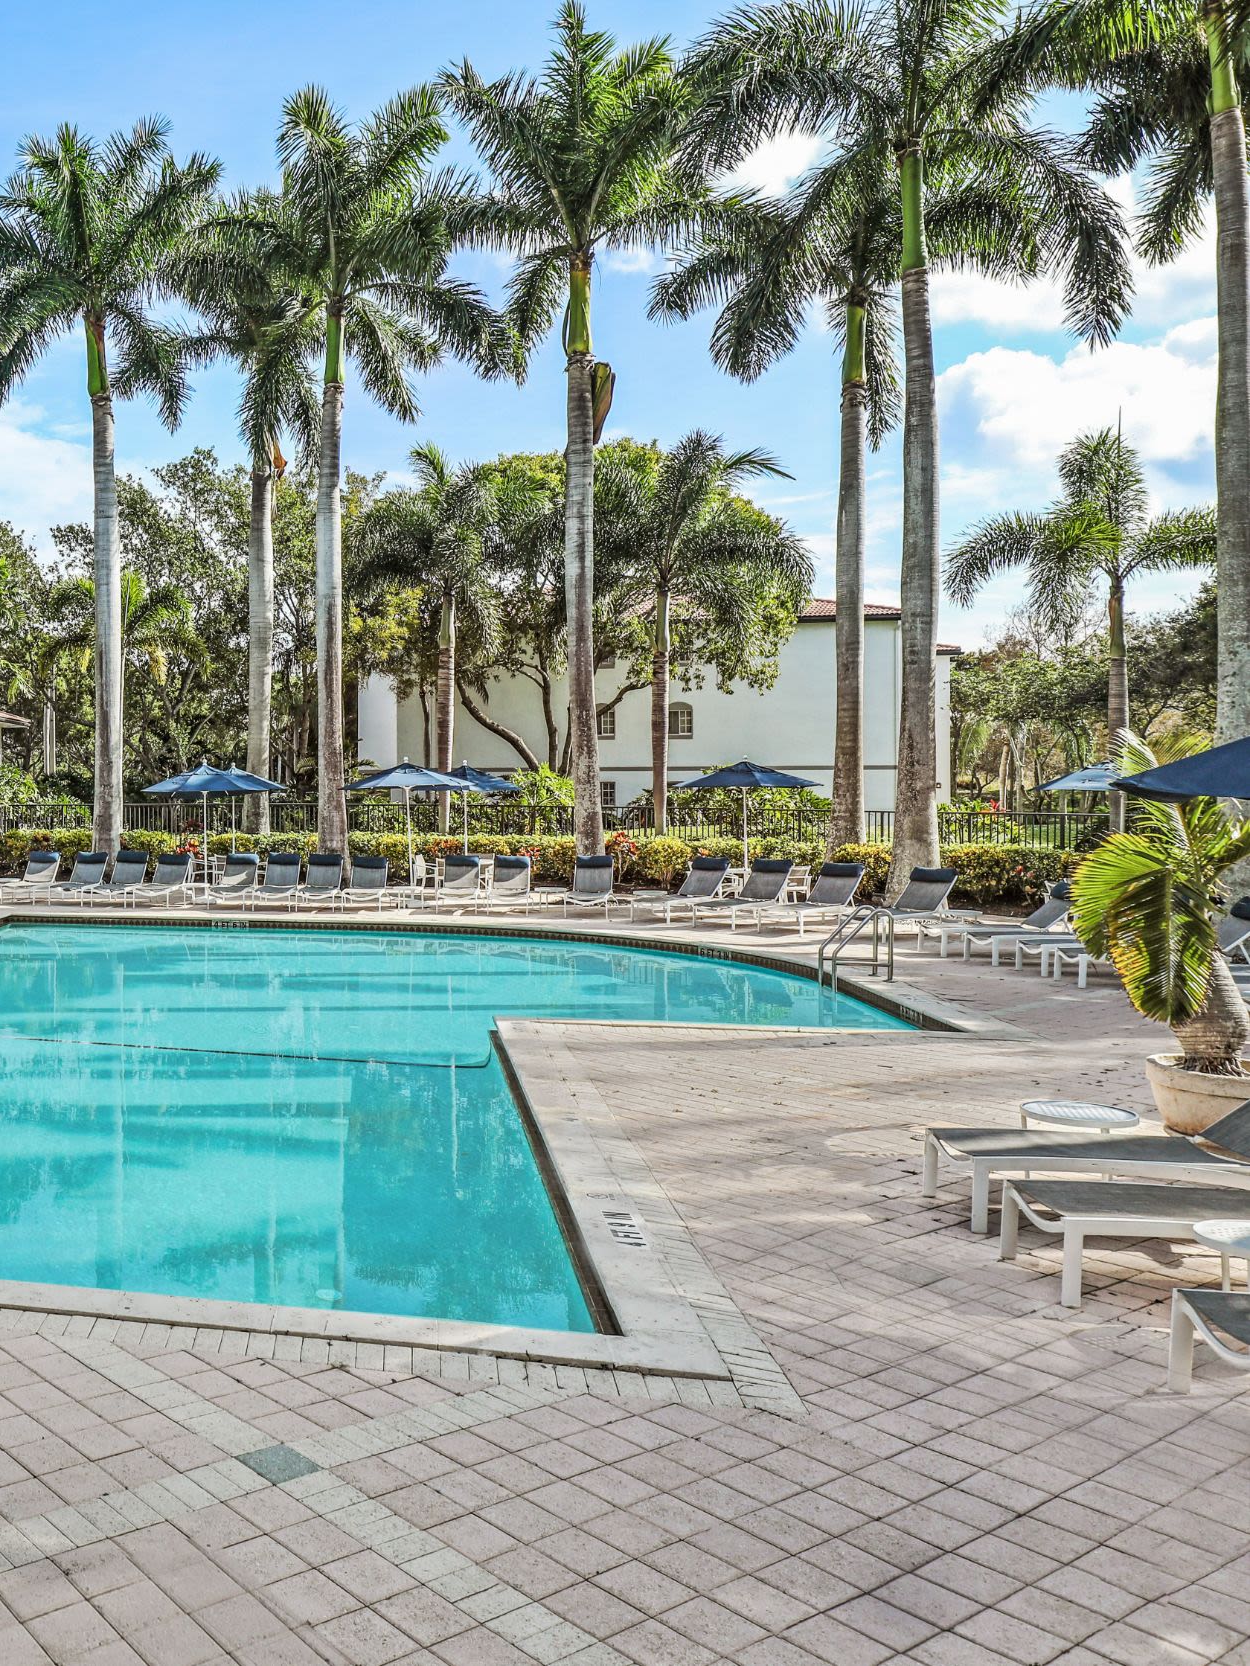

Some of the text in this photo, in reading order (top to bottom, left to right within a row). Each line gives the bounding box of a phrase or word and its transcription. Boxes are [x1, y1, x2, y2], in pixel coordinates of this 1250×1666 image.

[222, 921, 229, 929] FT
[602, 1211, 633, 1221] IN
[610, 1229, 643, 1239] FT
